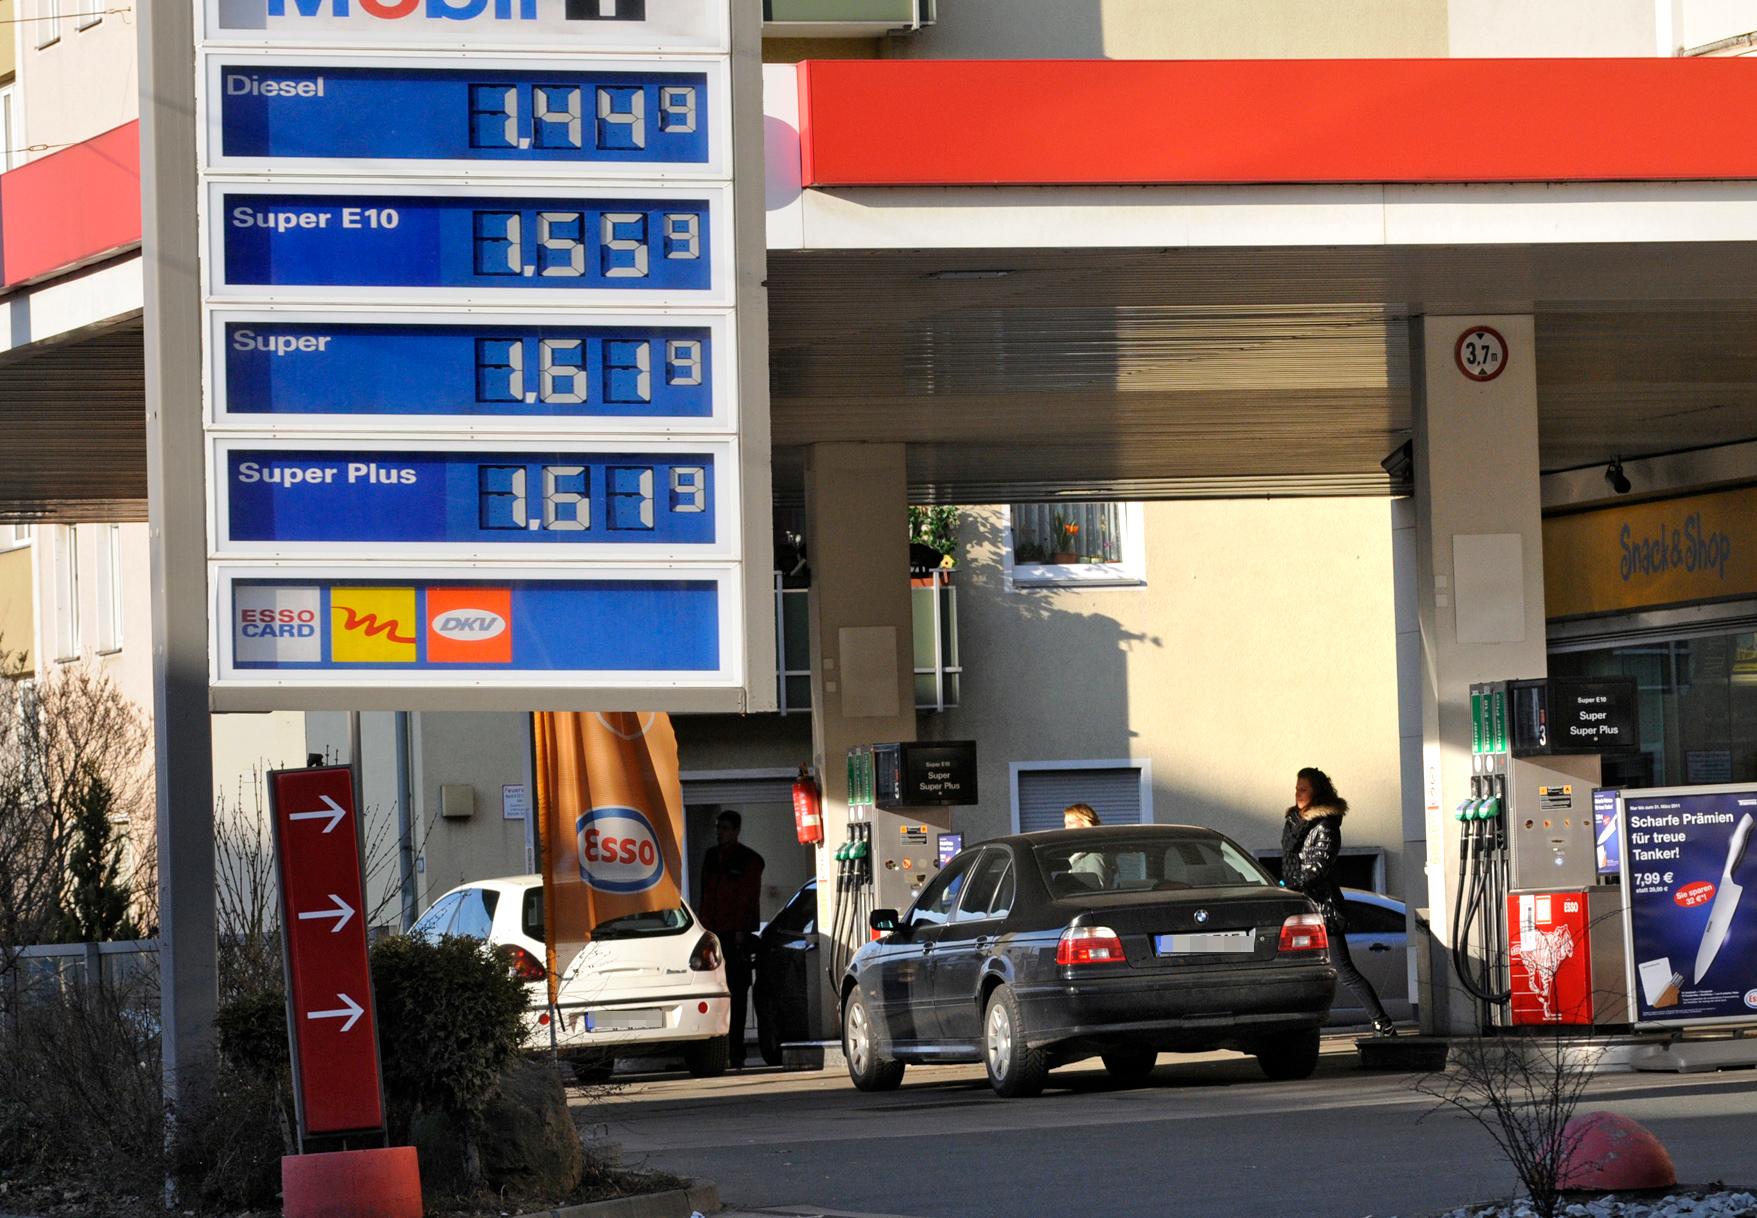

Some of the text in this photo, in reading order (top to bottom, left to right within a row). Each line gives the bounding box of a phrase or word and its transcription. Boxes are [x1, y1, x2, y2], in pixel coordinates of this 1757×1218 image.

[227, 75, 324, 98] Diesel
[232, 207, 400, 233] Super E10
[232, 329, 331, 356] Super
[1466, 342, 1498, 366] 3,7 m
[238, 461, 417, 487] Super Plus
[241, 608, 315, 623] ESSO
[241, 623, 316, 638] CARD
[438, 616, 498, 632] DKV
[1577, 696, 1595, 705] Super
[1579, 711, 1607, 721] Super
[1539, 725, 1547, 746] 3
[1570, 724, 1619, 737] Super Plus
[928, 771, 951, 780] Super
[920, 782, 960, 791] Super Plus
[1631, 812, 1734, 828] Scharfe Prämien
[1632, 832, 1686, 845] für treue
[584, 828, 655, 866] Esso
[1632, 847, 1680, 861] Tanker!
[1634, 872, 1674, 887] 7,99 €
[1675, 884, 1712, 900] Sie sparen
[1563, 901, 1579, 913] ESSO
[1685, 896, 1695, 906] 32
